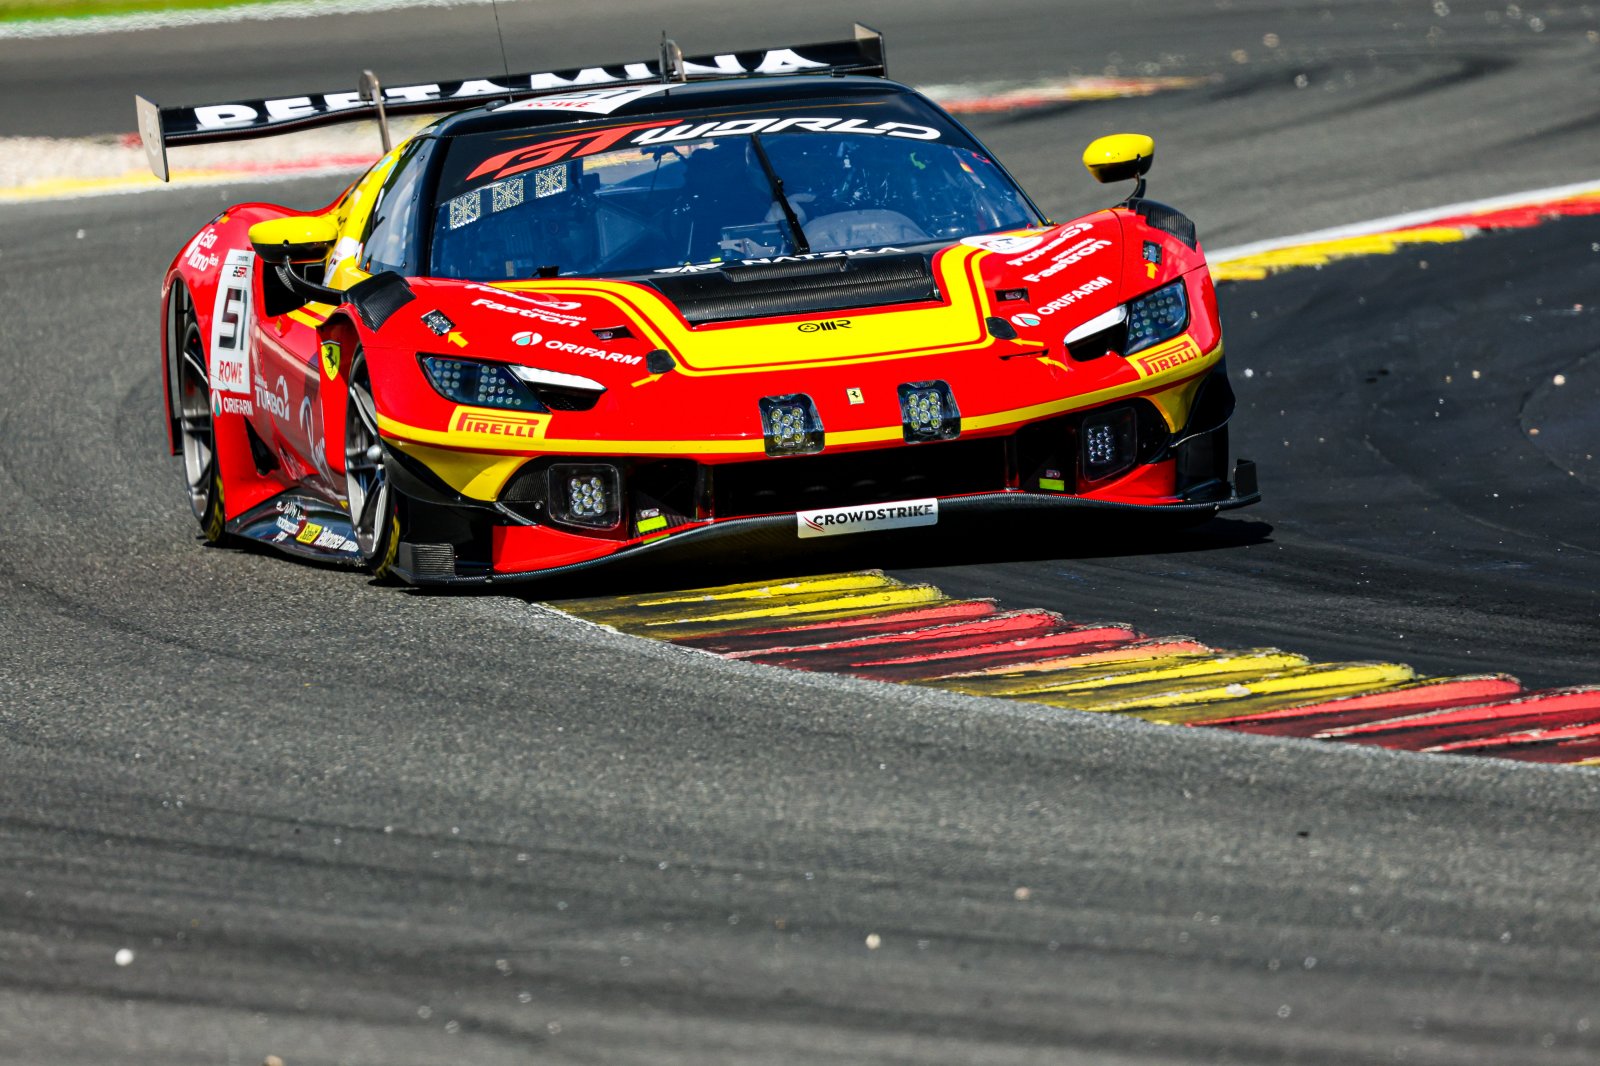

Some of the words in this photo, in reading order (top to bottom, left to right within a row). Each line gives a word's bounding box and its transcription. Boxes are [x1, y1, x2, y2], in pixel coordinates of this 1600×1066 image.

[465, 118, 684, 182] GT
[630, 117, 941, 146] WORLD
[741, 247, 906, 266] NATZKA
[1022, 239, 1113, 283] Fastron
[1036, 275, 1113, 315] ORIFARM
[216, 286, 248, 352] 51
[470, 298, 581, 328] Fastron
[544, 339, 643, 366] ORIFARM
[1136, 340, 1198, 377] PIRELLI
[218, 360, 243, 384] ROWE
[222, 396, 254, 417] ORIFARM
[456, 411, 540, 438] PIRELLI
[812, 504, 935, 527] CROWDSTRIKE
